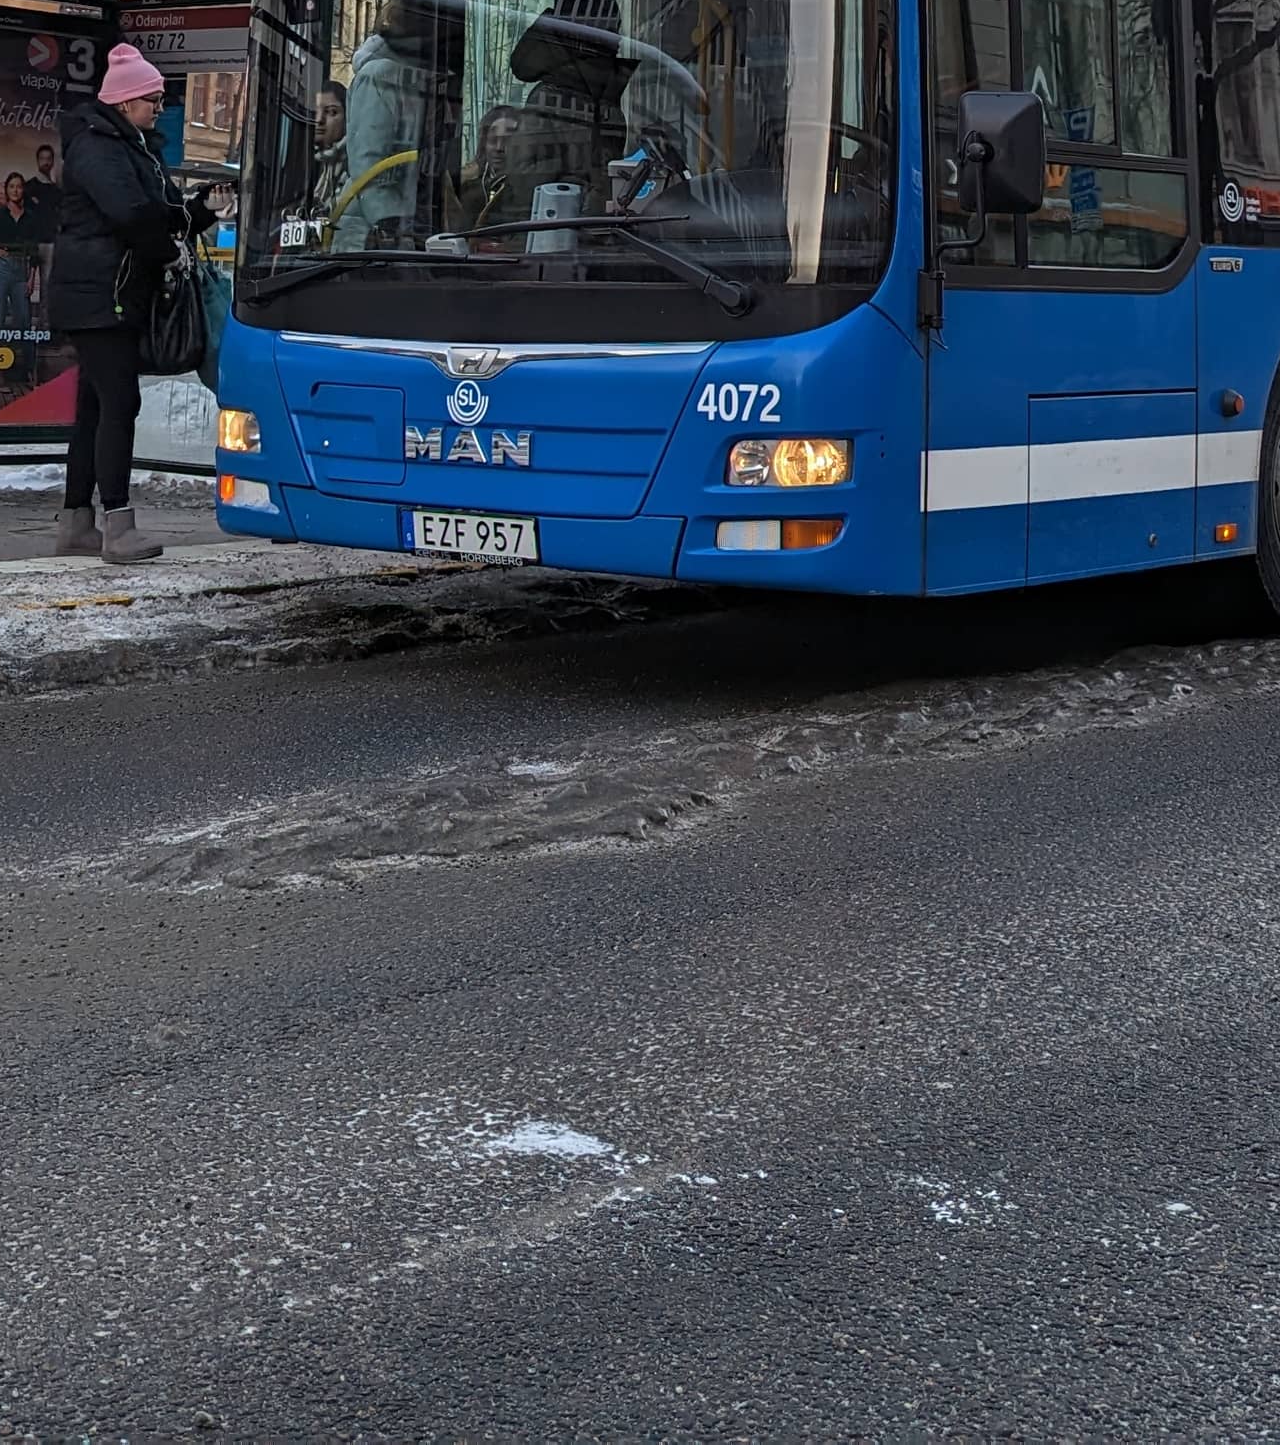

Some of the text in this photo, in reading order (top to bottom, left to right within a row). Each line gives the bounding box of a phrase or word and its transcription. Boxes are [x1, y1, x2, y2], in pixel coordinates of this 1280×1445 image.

[135, 13, 185, 28] Odenplan
[147, 33, 185, 50] 67 72
[66, 38, 96, 82] 3
[20, 73, 63, 91] viaplay
[1226, 190, 1237, 204] SL
[0, 329, 22, 342] nya
[23, 325, 51, 343] såpa
[457, 388, 477, 407] SL
[697, 382, 781, 422] 4072
[404, 426, 533, 467] MAN
[423, 515, 524, 554] EZF 957
[460, 552, 524, 567] HORNSBERG
